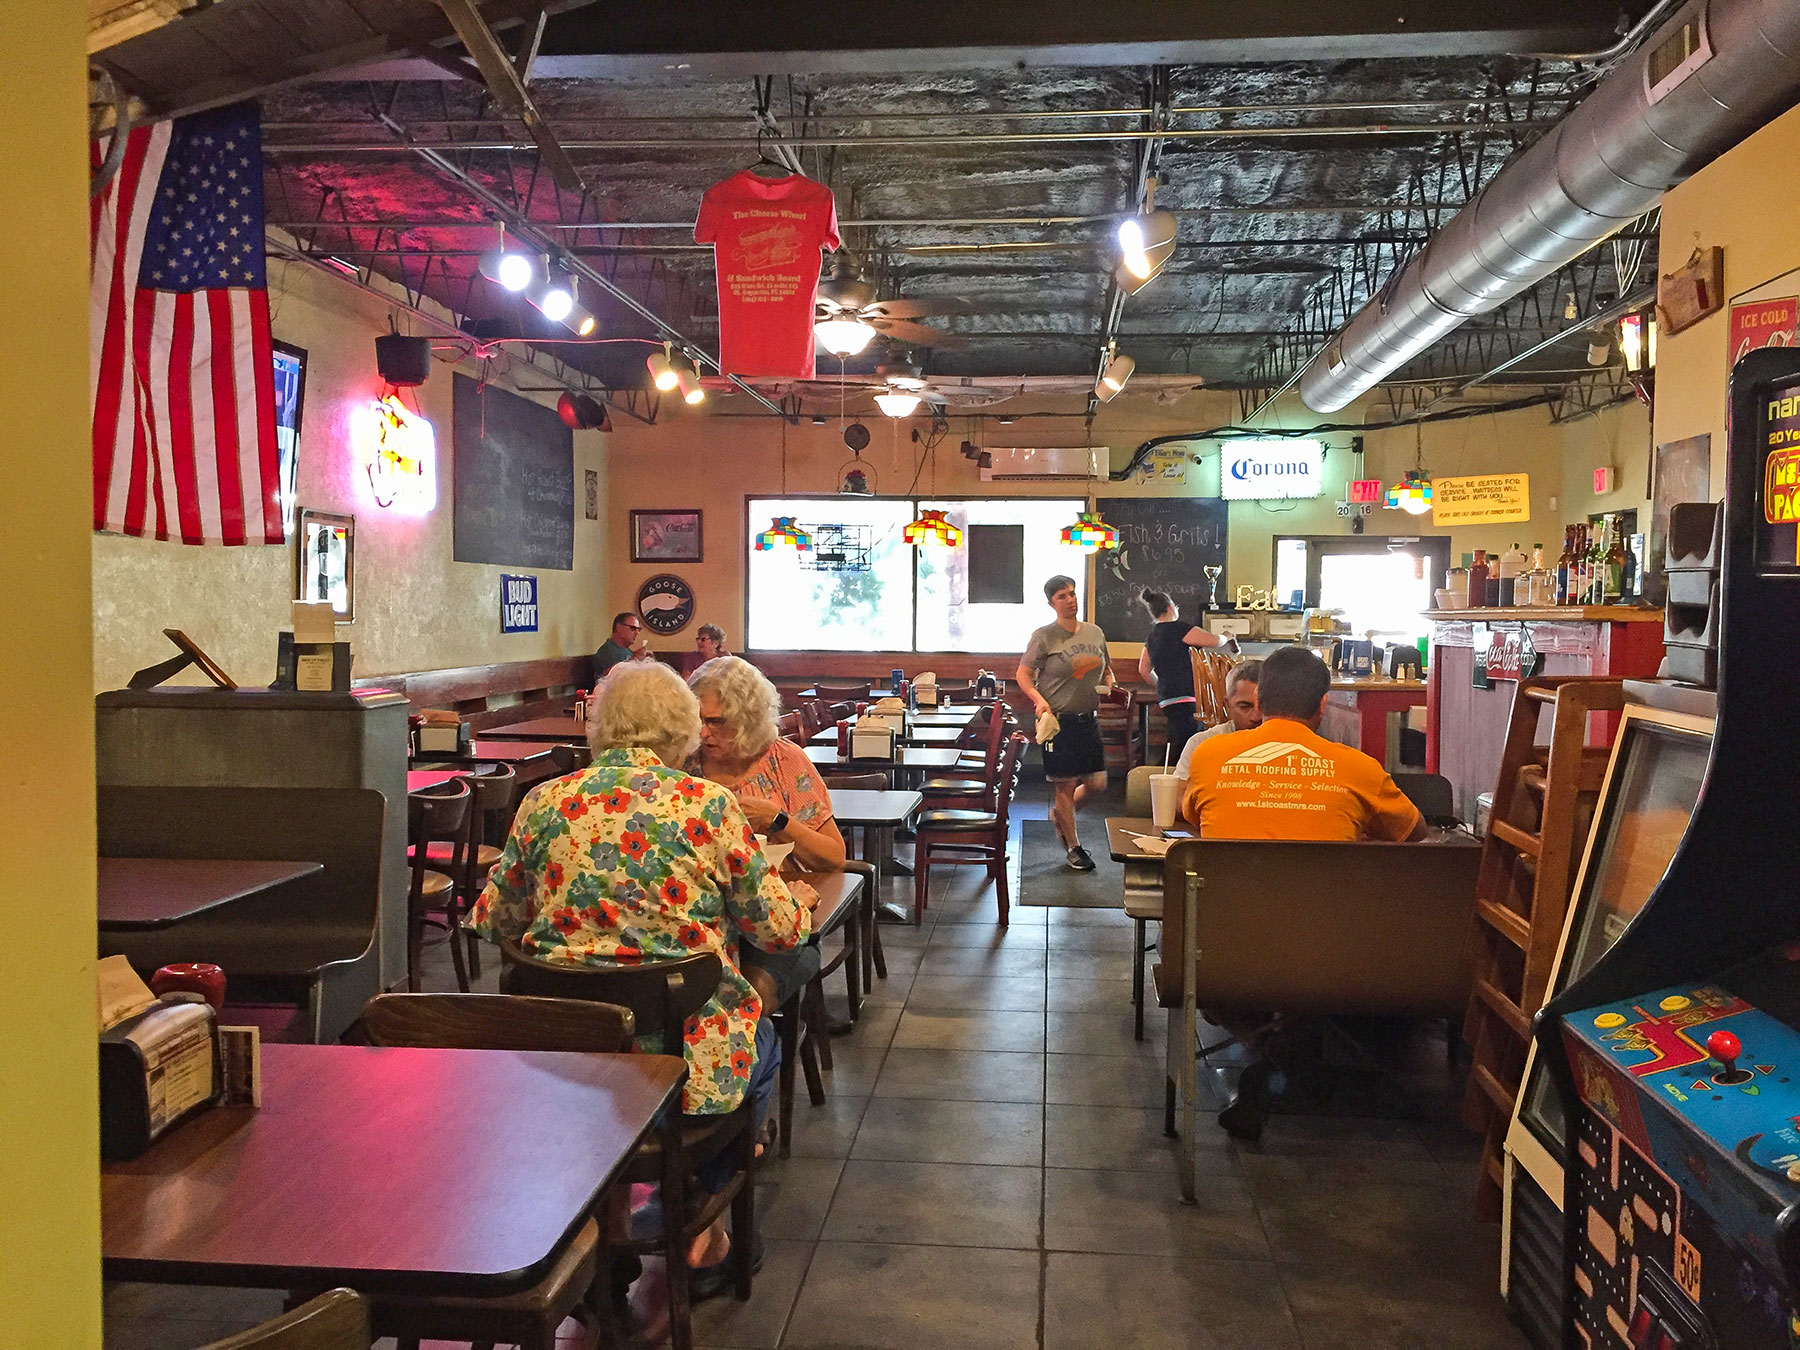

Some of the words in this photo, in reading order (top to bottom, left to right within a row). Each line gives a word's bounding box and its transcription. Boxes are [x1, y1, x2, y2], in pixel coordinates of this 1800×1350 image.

[732, 211, 748, 220] The
[750, 209, 778, 218] Cheese
[780, 210, 807, 221] Wheel
[736, 274, 775, 283] Sandwich
[777, 274, 801, 283] Board
[1741, 313, 1758, 329] ICE
[1760, 309, 1788, 326] COLD
[1768, 430, 1784, 445] 20
[1231, 458, 1309, 482] Corona
[1472, 486, 1502, 494] WAITRESS
[1478, 479, 1503, 487] SEATED
[1353, 481, 1380, 501] EXIT
[1452, 494, 1470, 502] RIGHT
[1337, 507, 1349, 516] 20
[1360, 505, 1372, 514] 16
[508, 580, 532, 604] BUD
[649, 580, 683, 594] GOOSE
[1235, 584, 1280, 611] Eat
[505, 603, 537, 628] LIGHT
[648, 613, 685, 628] ISLAND
[1300, 757, 1335, 769] COAST
[1221, 765, 1251, 774] METAL
[1255, 765, 1297, 776] ROOFING
[1301, 768, 1336, 778] SUPPLY
[1216, 779, 1261, 790] Knowledge
[1269, 780, 1302, 791] Service
[1311, 782, 1349, 794] Selection
[1260, 791, 1283, 799] Since
[1663, 1082, 1689, 1102] MOVE
[1774, 1127, 1799, 1144] Fire
